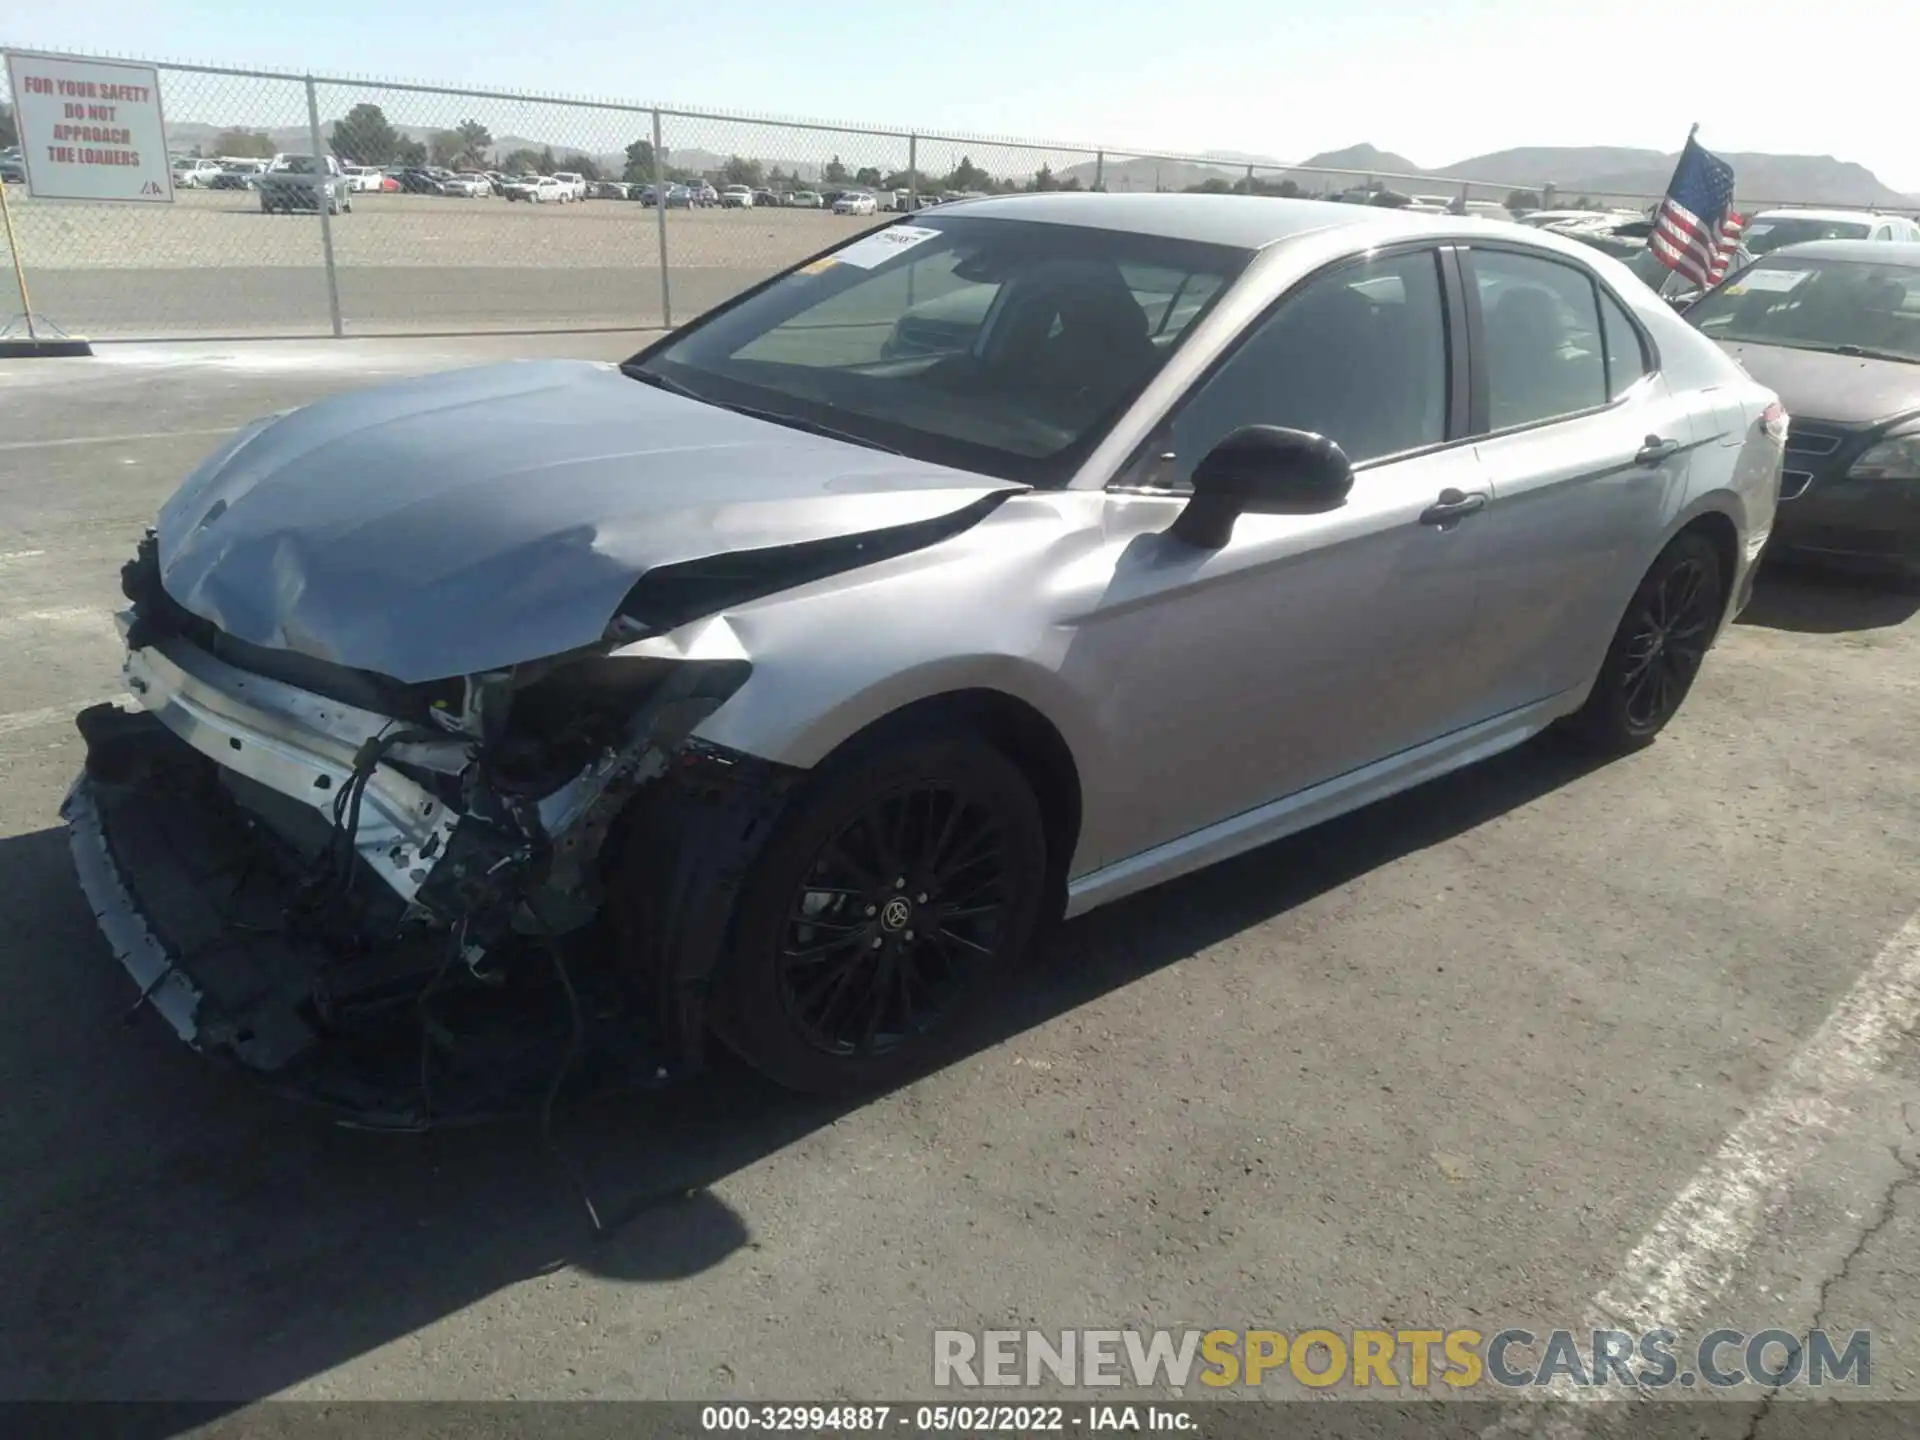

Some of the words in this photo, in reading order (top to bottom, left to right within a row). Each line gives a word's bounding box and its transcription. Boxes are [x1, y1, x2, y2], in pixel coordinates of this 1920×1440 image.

[25, 76, 53, 95] FOR
[57, 79, 97, 98] YOUR
[100, 83, 149, 103] SAFETY
[64, 103, 85, 120] DO
[88, 105, 116, 121] NOT
[53, 124, 131, 144] APPROACH
[47, 146, 75, 163] THE
[78, 148, 140, 167] LOADERS
